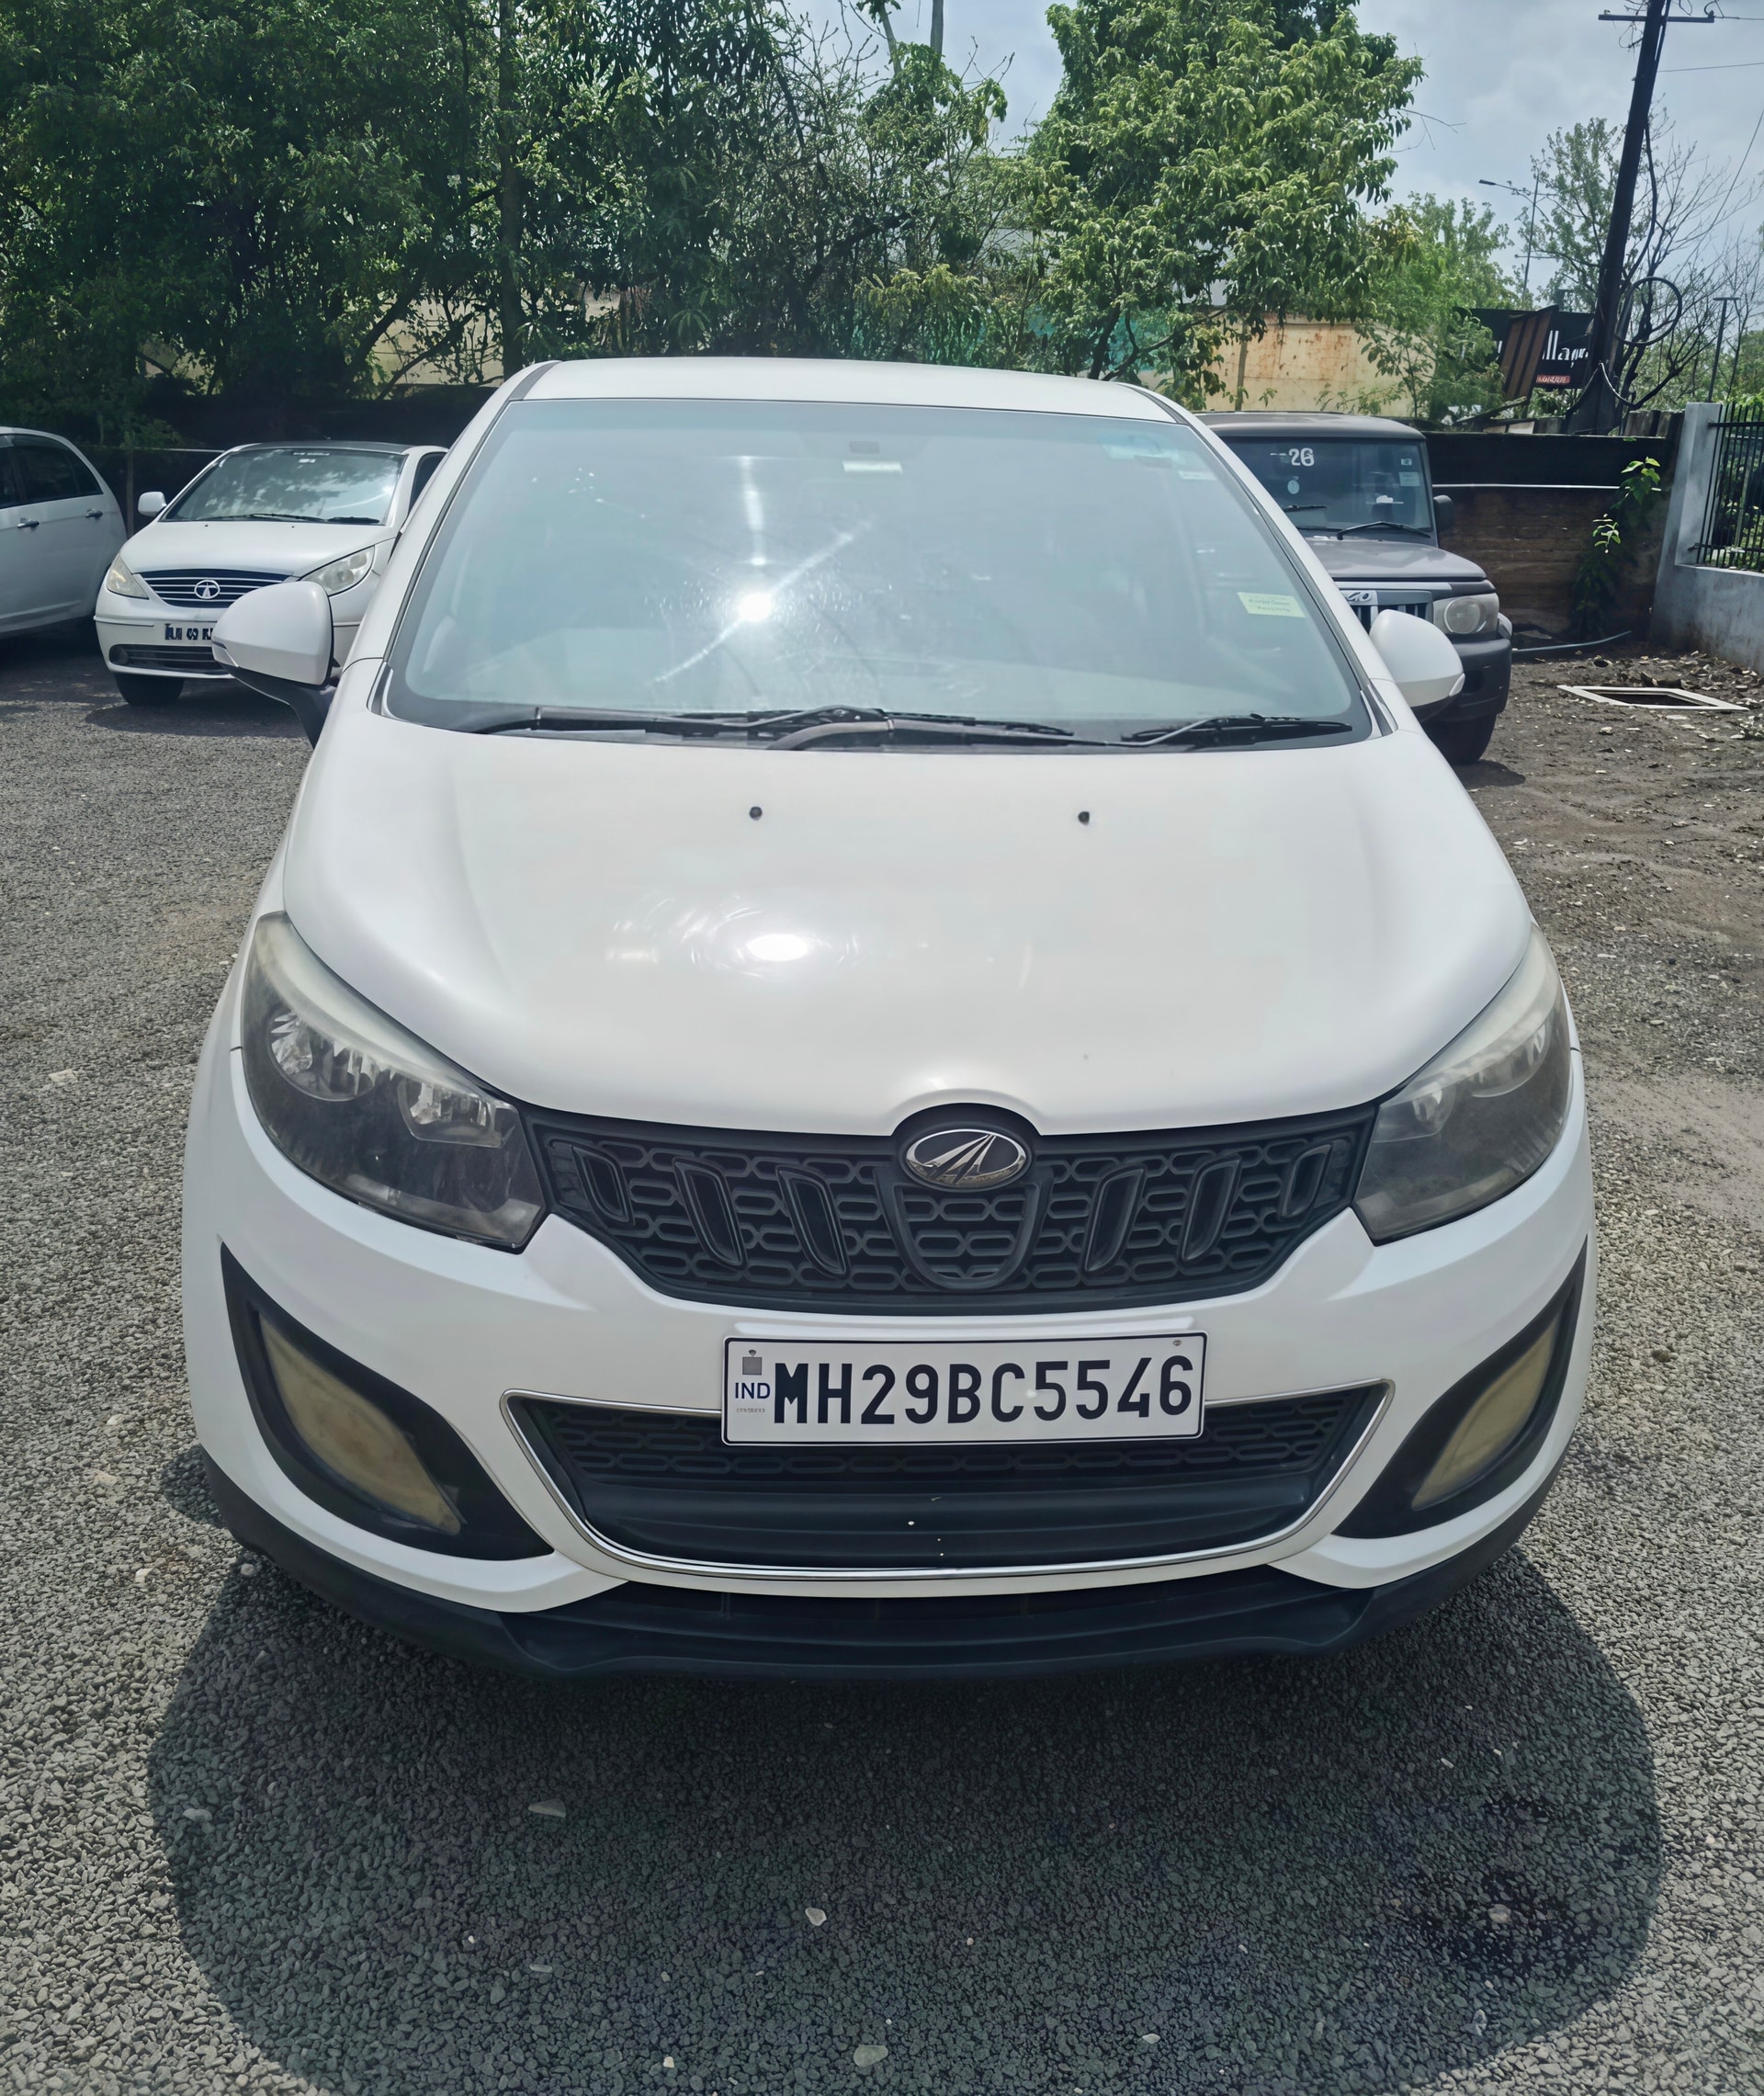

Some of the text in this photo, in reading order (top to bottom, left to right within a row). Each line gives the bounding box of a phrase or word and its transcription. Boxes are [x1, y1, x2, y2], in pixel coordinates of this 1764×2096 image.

[1288, 448, 1315, 467] 26
[735, 1382, 771, 1399] IND
[774, 1354, 1193, 1424] MH29BC5546
